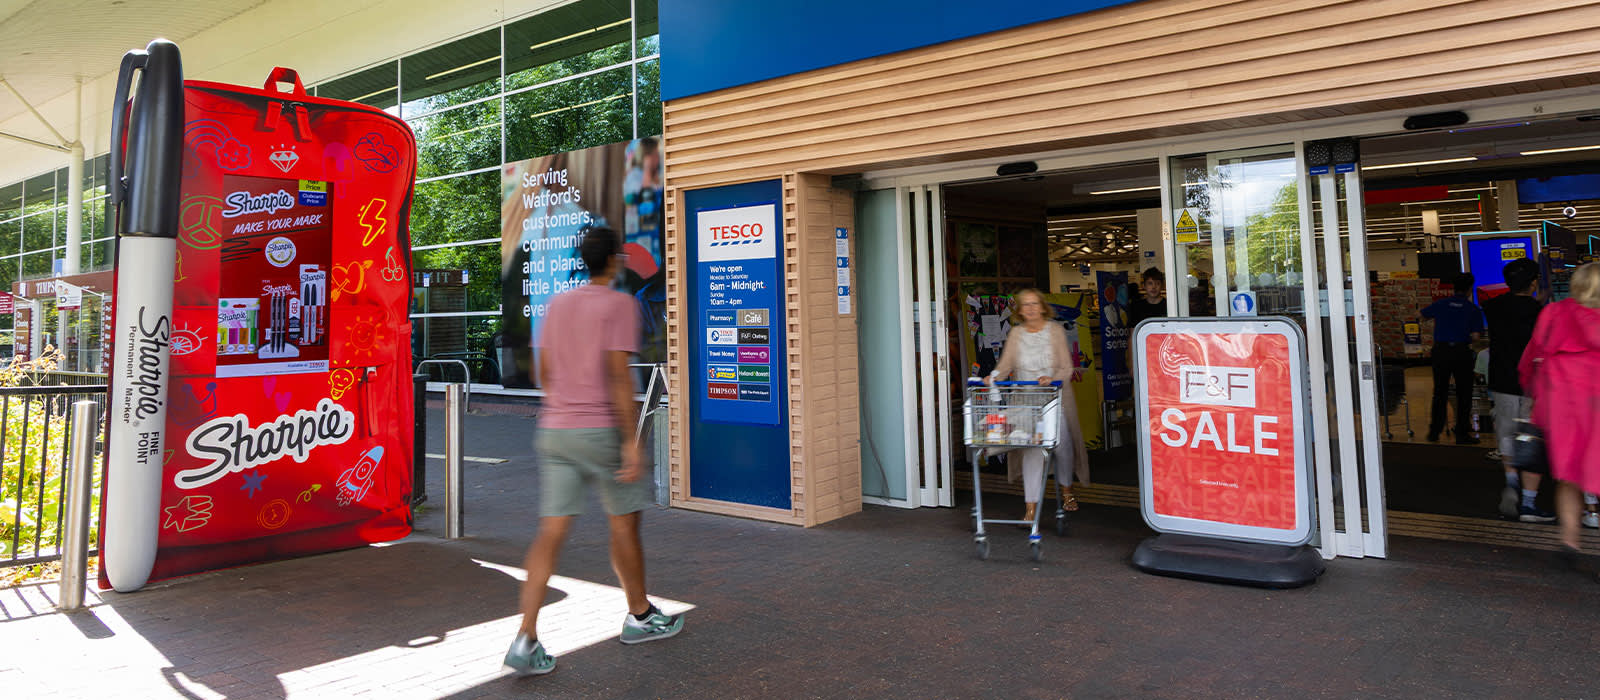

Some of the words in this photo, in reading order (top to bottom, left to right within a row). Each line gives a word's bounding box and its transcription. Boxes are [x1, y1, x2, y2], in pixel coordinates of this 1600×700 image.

[522, 168, 568, 188] Serving
[223, 190, 294, 215] Sharpie
[522, 186, 581, 210] Watford's
[232, 221, 264, 235] MAKE
[266, 218, 291, 231] YOUR
[292, 214, 324, 227] MARK
[522, 210, 594, 231] customers,
[522, 229, 589, 253] communit
[709, 223, 763, 241] TESCO
[522, 256, 545, 274] and
[549, 255, 589, 276] plane
[709, 265, 725, 273] We're
[727, 265, 743, 273] open
[522, 279, 550, 297] little
[709, 281, 725, 291] 6am
[709, 298, 725, 306] 10am
[729, 297, 742, 306] 4pm
[709, 315, 731, 323] Pharmacy
[744, 314, 762, 324] Café
[126, 325, 137, 379] Permanent
[136, 306, 170, 420] Sharpie
[710, 387, 737, 395] TIMPSON
[1185, 370, 1249, 401] F&F
[123, 387, 133, 424] Marker
[181, 403, 349, 483] Sharpie
[1159, 408, 1280, 457] SALE
[137, 432, 149, 464] POINT
[150, 431, 160, 456] FINE
